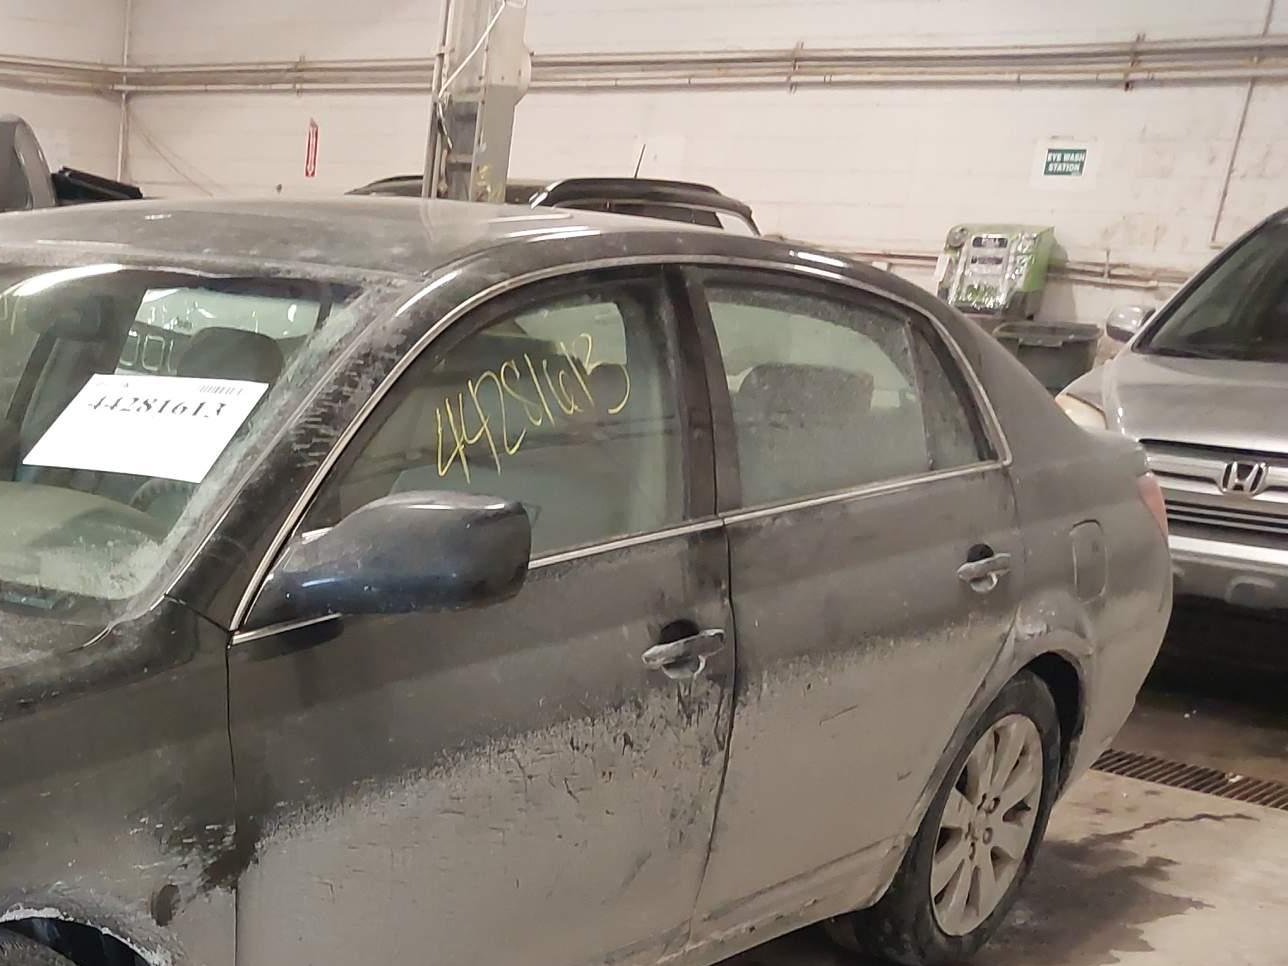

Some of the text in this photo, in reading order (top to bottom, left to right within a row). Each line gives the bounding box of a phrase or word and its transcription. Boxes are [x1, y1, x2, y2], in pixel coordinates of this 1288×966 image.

[1047, 152, 1062, 161] EYE
[1048, 162, 1080, 171] STATION
[436, 333, 631, 484] 44281613
